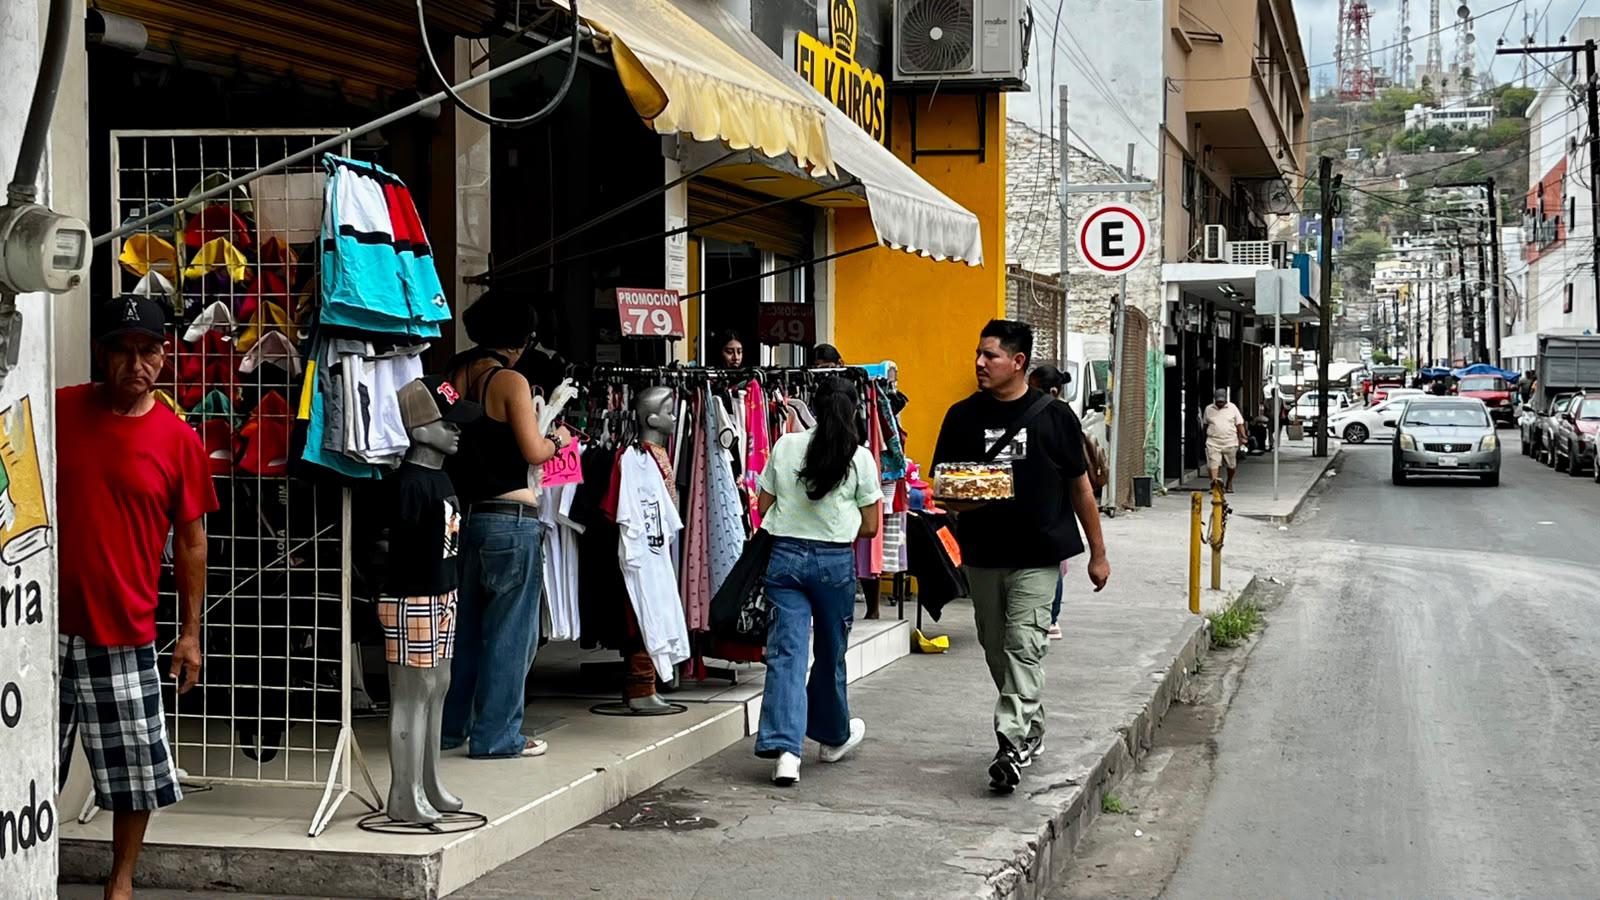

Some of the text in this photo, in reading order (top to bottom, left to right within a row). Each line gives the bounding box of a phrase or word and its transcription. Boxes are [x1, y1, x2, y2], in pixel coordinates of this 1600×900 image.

[824, 58, 883, 143] KAIROS
[1101, 221, 1124, 257] E
[0, 779, 54, 859] ndo
